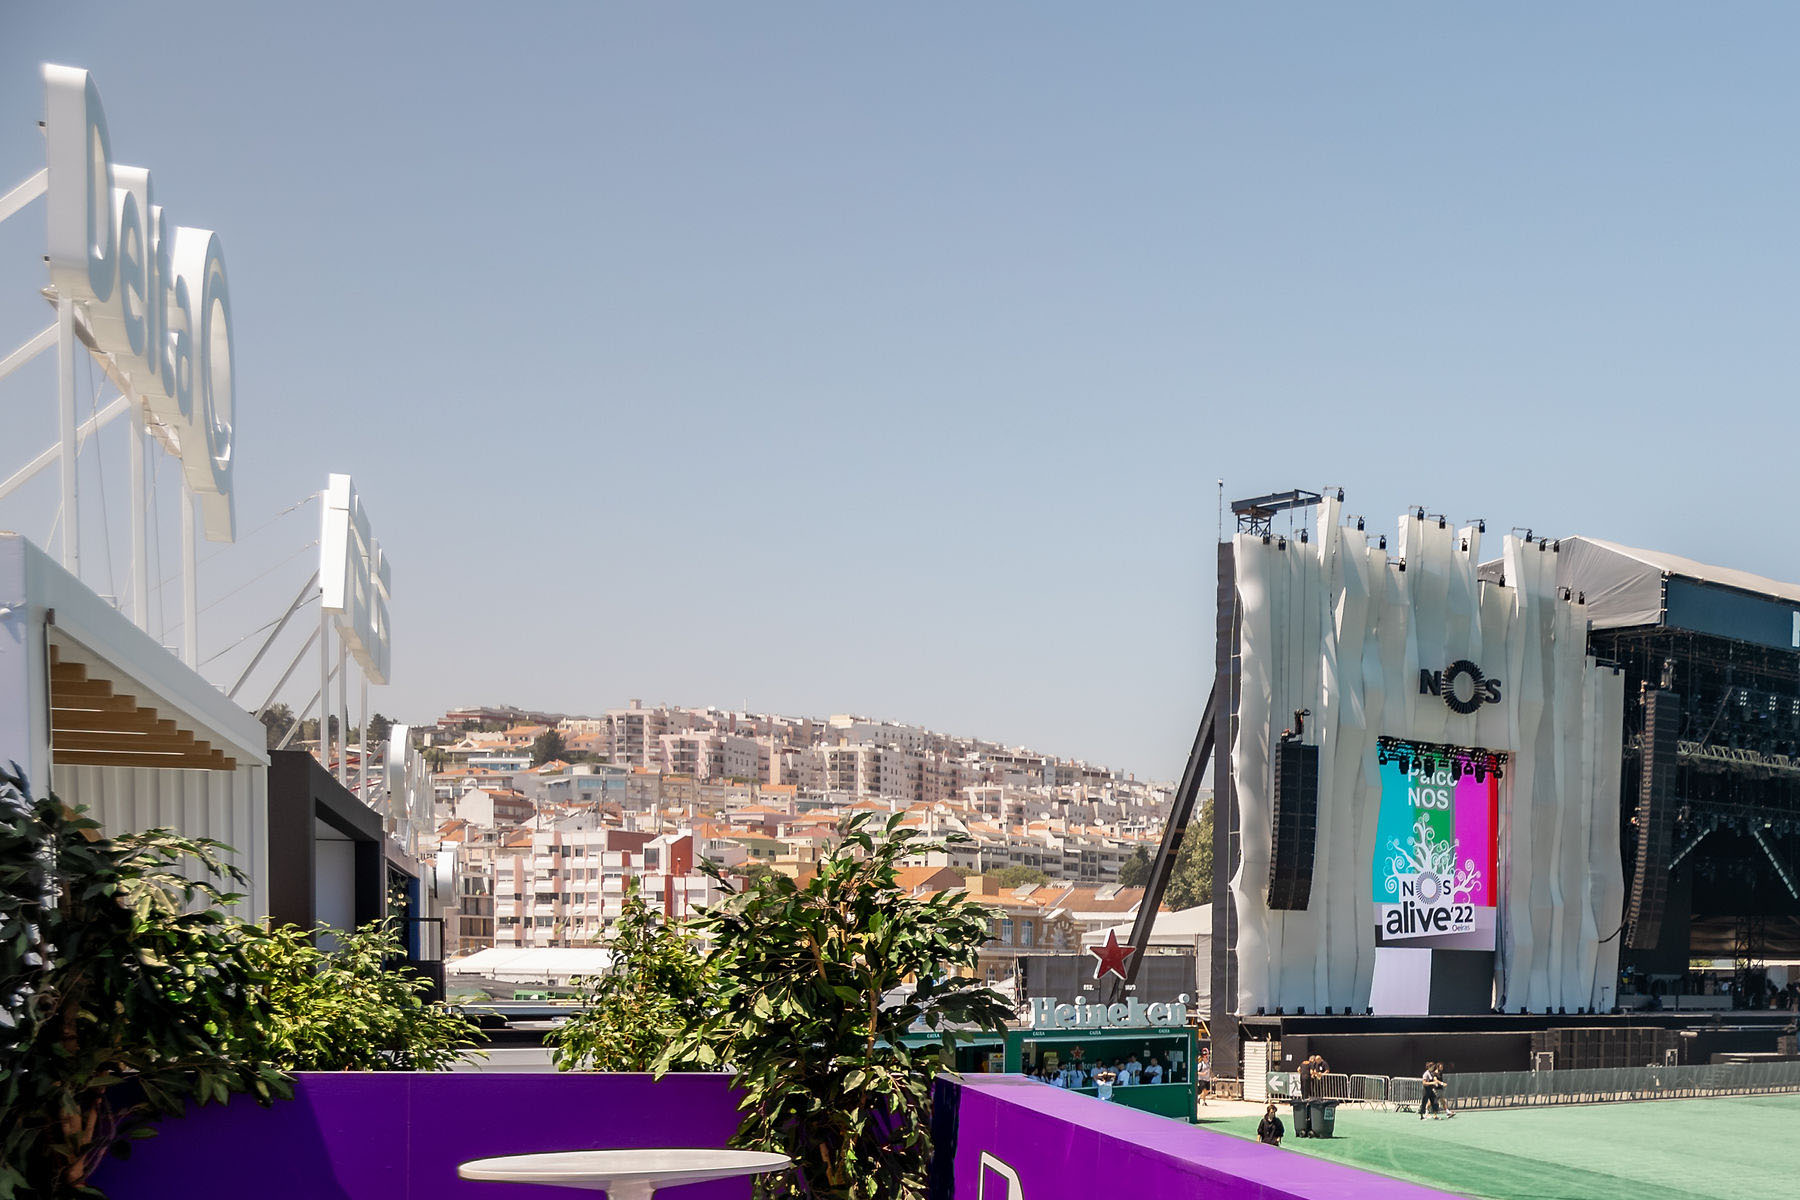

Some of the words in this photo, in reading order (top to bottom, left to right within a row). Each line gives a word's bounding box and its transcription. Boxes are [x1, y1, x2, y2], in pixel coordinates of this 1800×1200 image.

[1420, 660, 1502, 714] NOS
[1408, 787, 1449, 810] NOS
[1402, 871, 1452, 905] NOS
[1028, 993, 1190, 1029] Heineken
